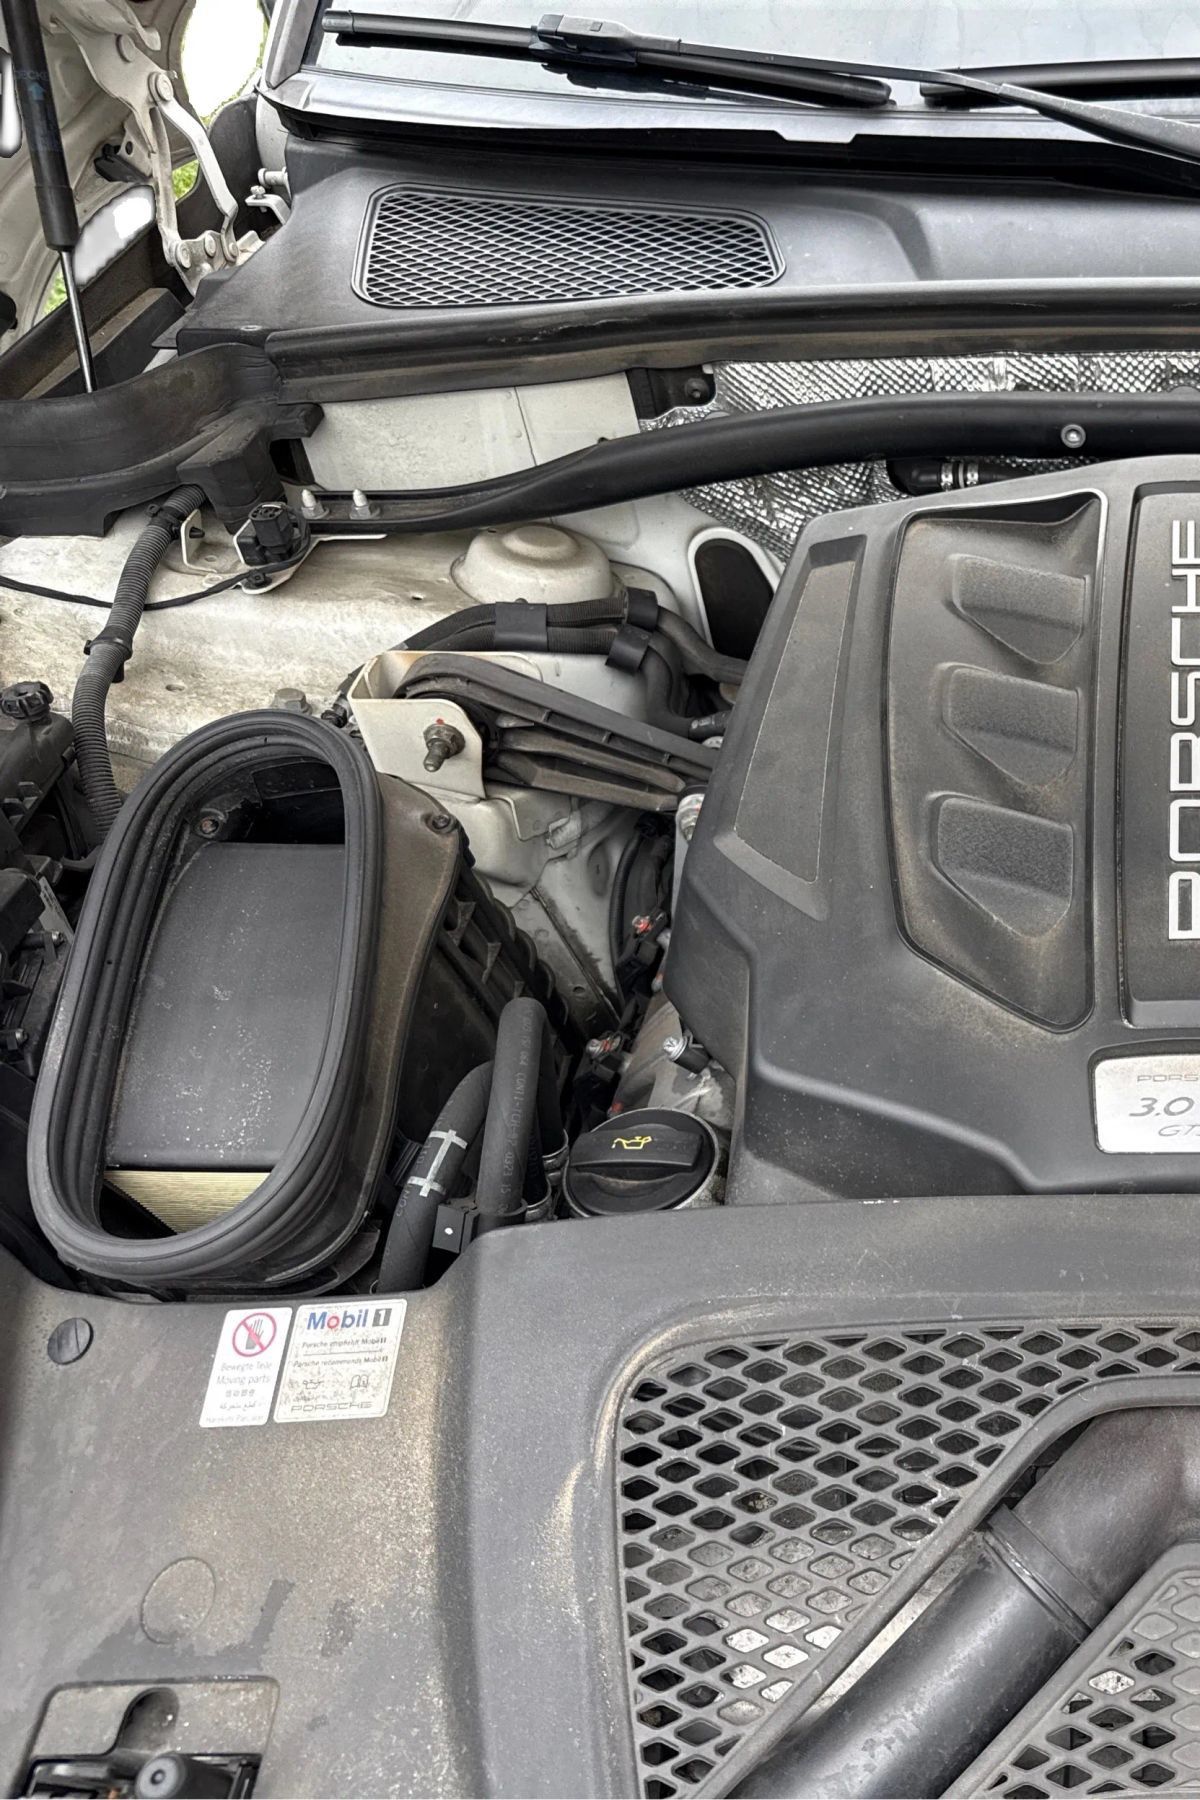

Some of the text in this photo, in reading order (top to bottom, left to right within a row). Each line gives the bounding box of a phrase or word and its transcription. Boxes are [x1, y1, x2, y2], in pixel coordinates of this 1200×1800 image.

[1128, 1096, 1196, 1117] 3.0
[306, 1309, 370, 1330] Mobil
[216, 1373, 271, 1385] Moving parts
[290, 1401, 373, 1413] PORSCHE
